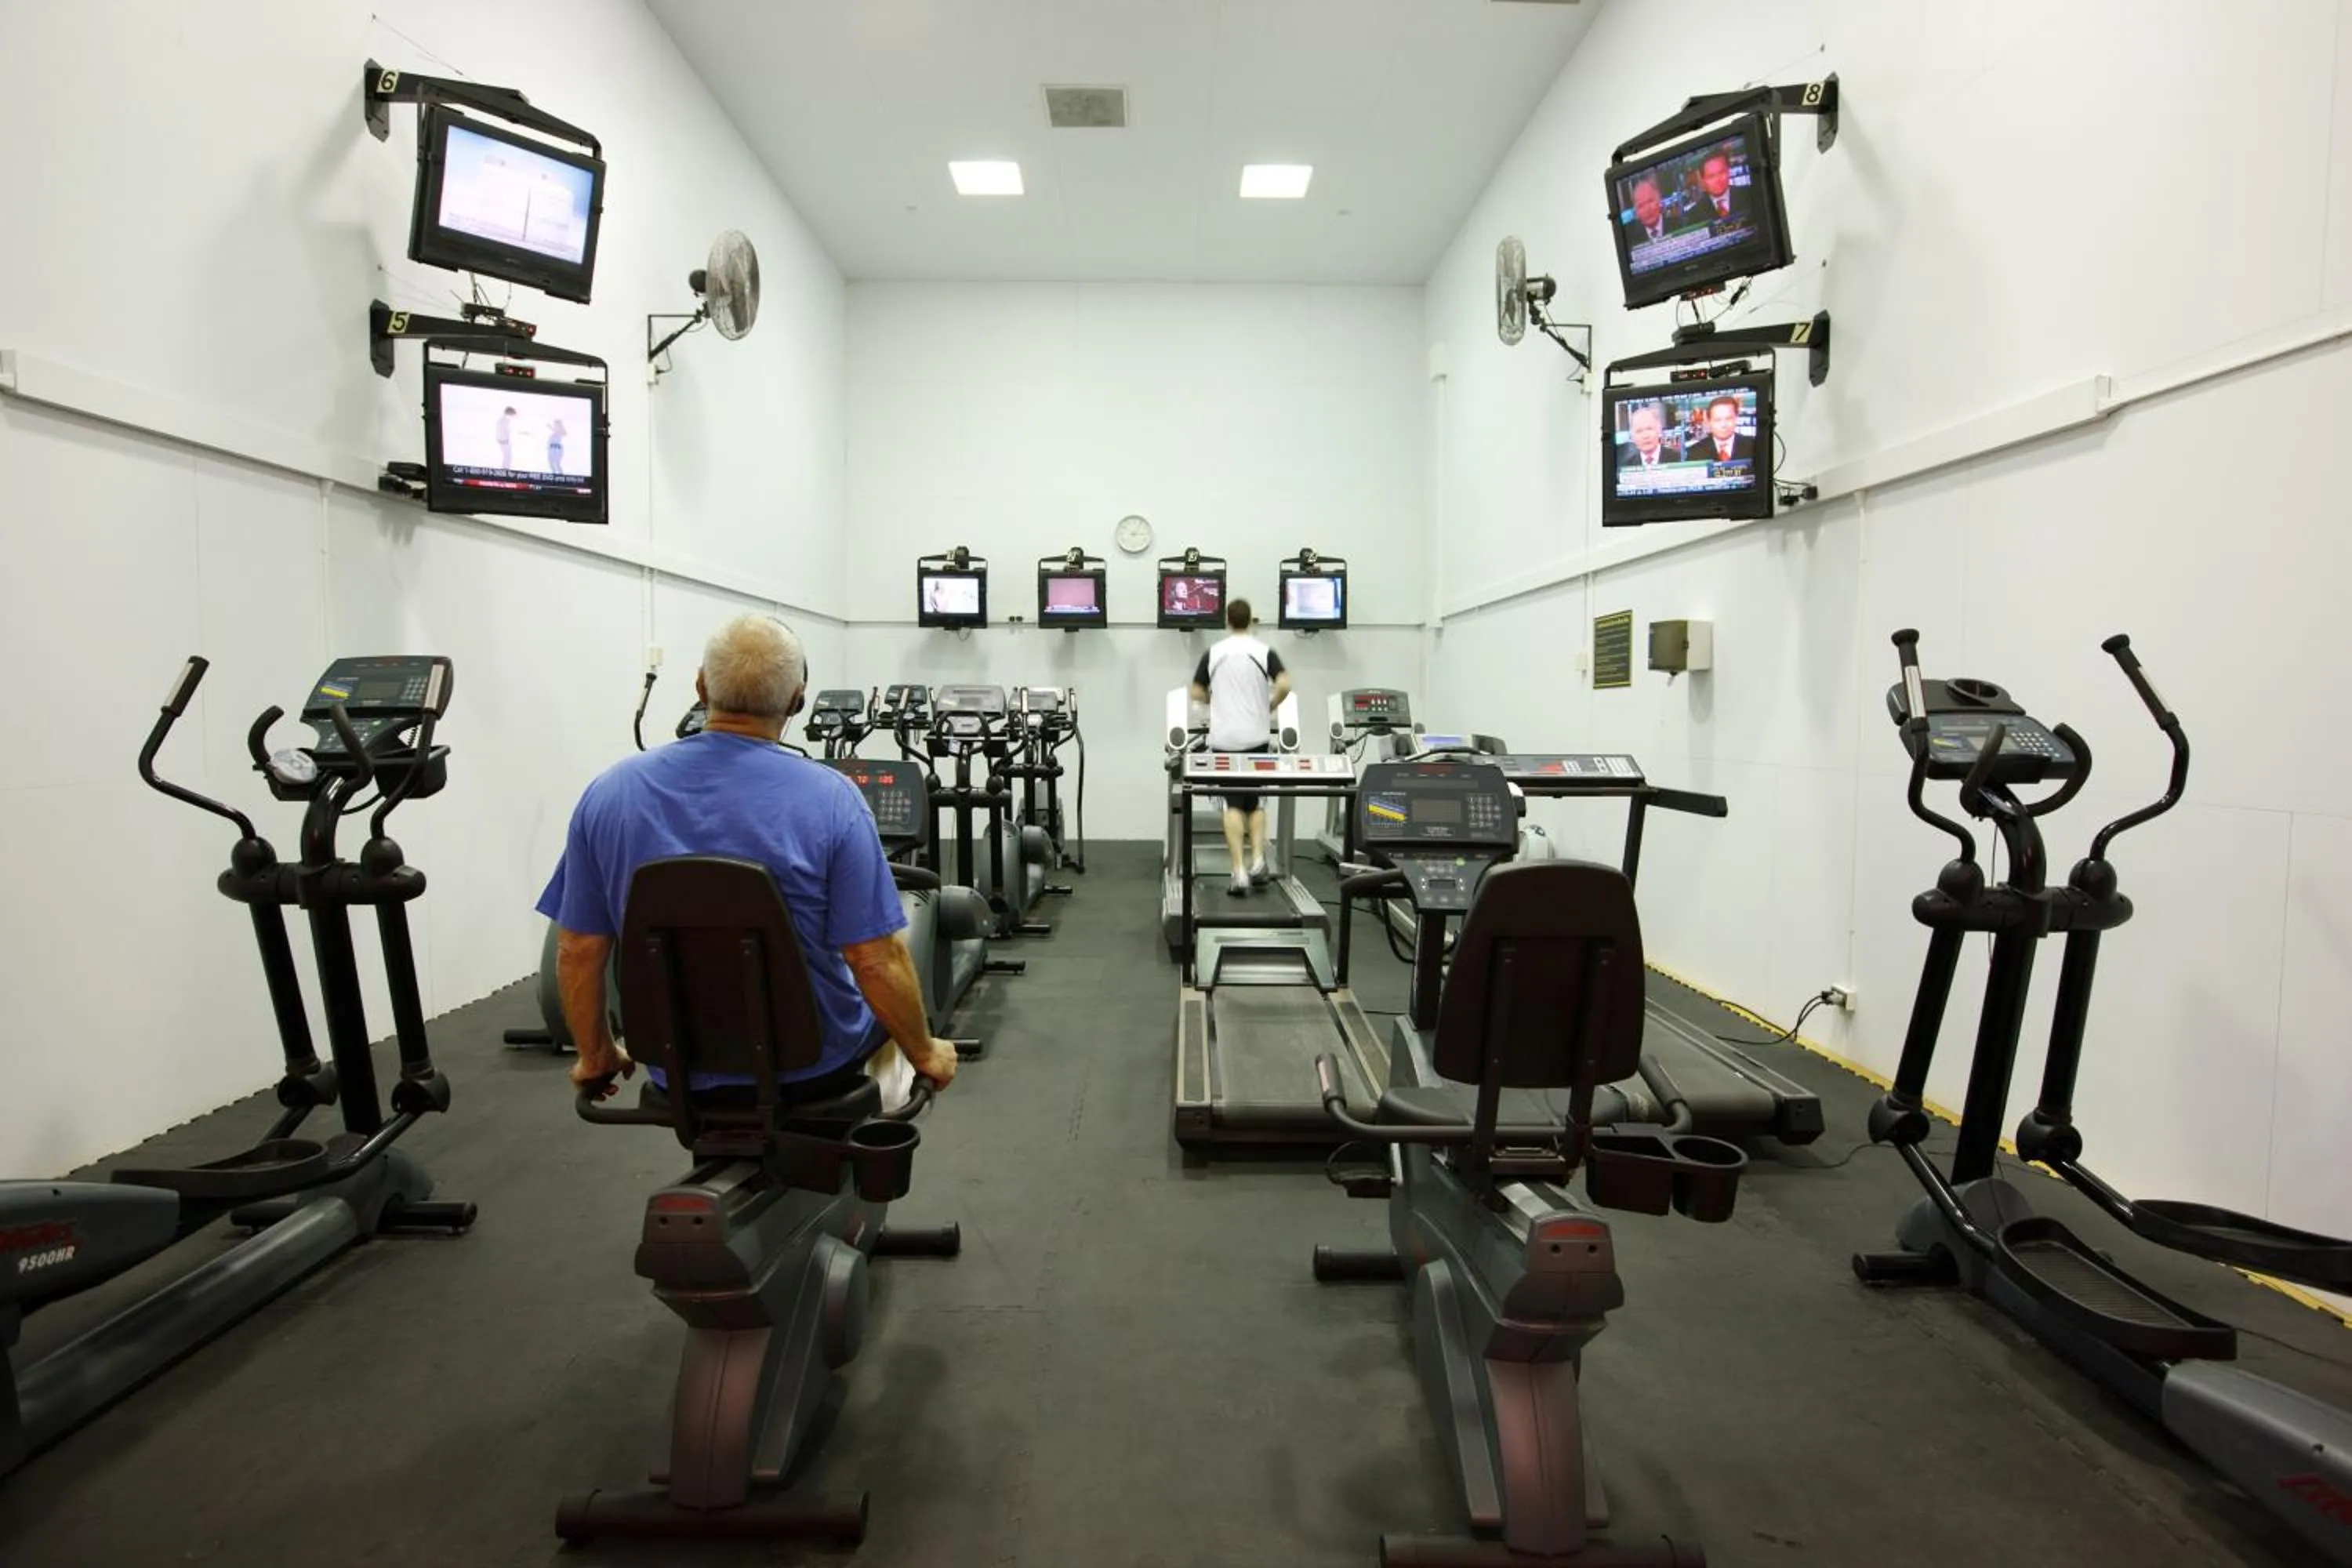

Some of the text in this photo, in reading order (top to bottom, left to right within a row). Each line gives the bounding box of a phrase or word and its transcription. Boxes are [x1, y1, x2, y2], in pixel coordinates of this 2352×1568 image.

[381, 71, 396, 91] 6
[1806, 83, 1820, 103] 8
[391, 312, 406, 332] 5
[1794, 322, 1810, 341] 7
[17, 1244, 76, 1275] 9500HR
